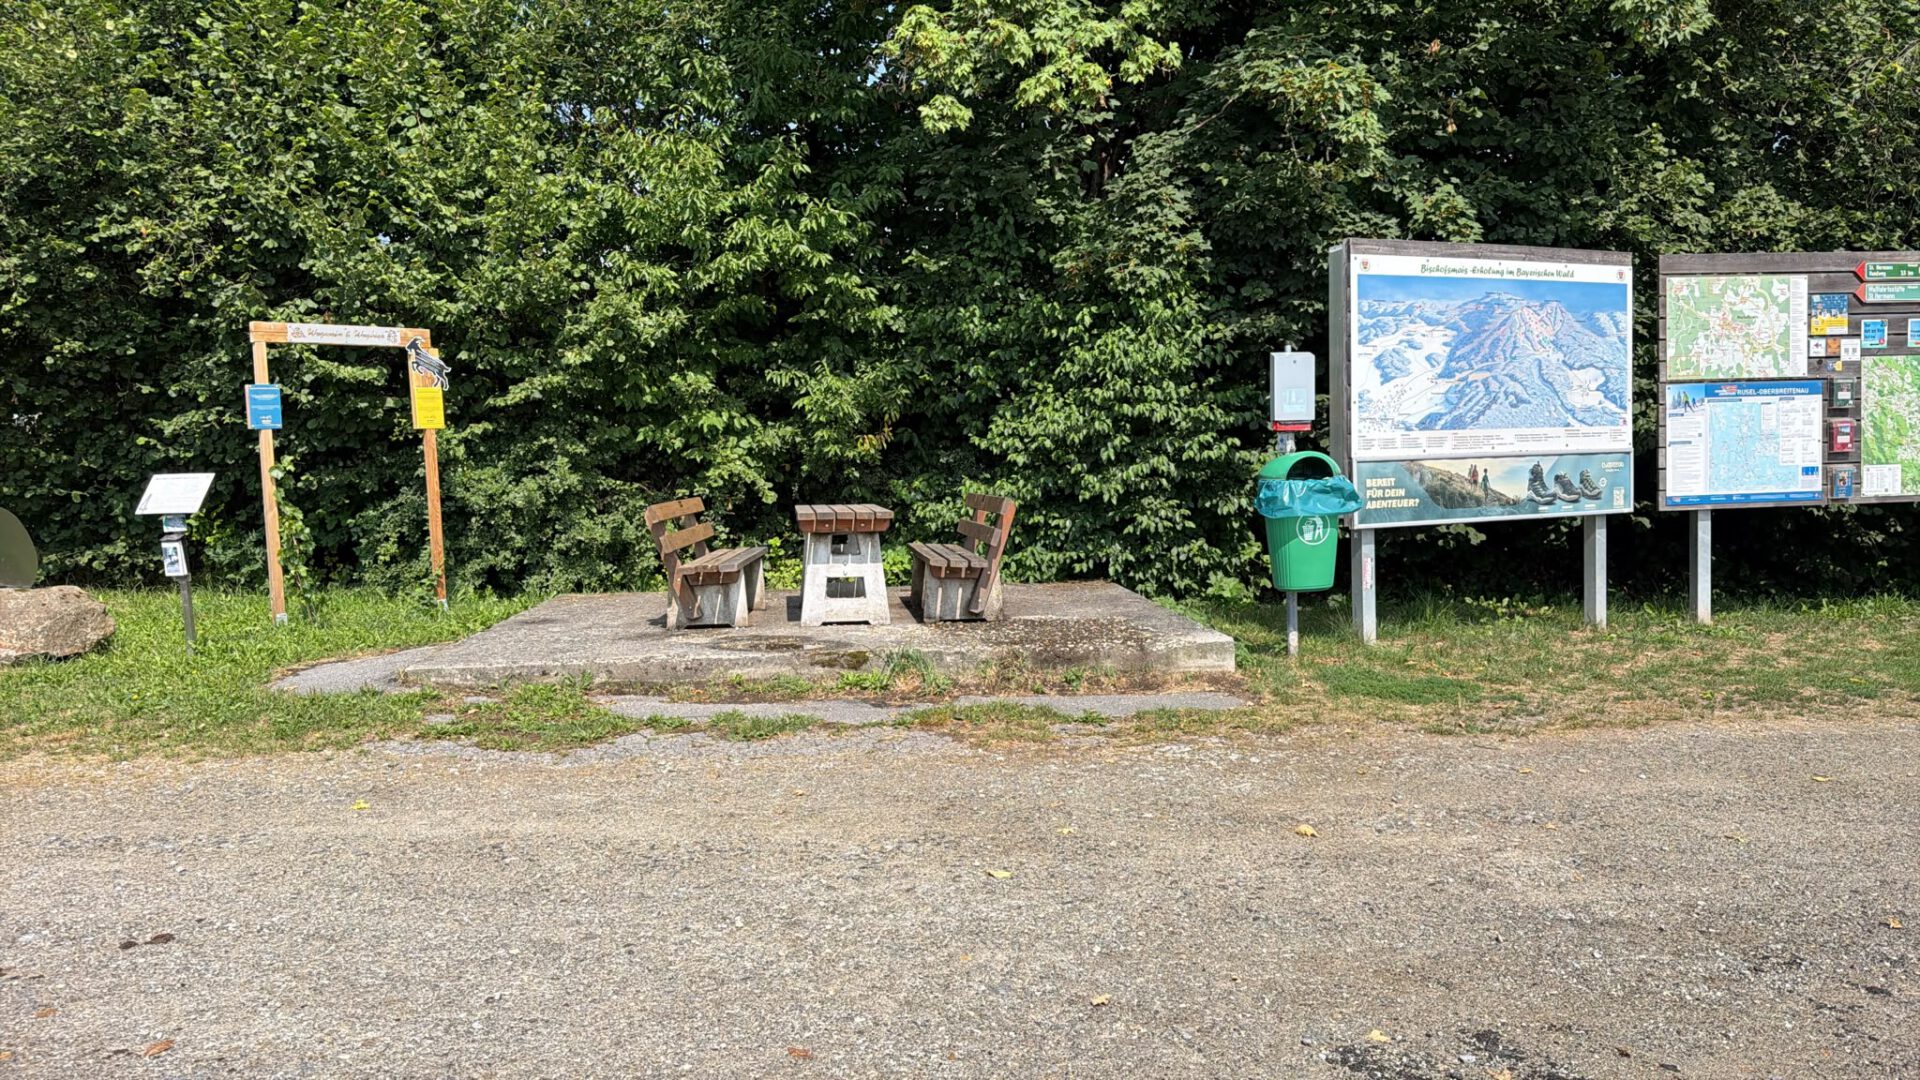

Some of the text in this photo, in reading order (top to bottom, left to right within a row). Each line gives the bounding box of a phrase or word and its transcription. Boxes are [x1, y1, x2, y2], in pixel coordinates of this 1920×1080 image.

[1506, 267, 1515, 277] im
[1516, 267, 1555, 279] Bayerischen
[1556, 269, 1575, 278] Wald
[1365, 477, 1396, 488] BEREIT
[1366, 488, 1406, 499] FÜR DEIN
[1365, 498, 1420, 510] ABENTEUER?
